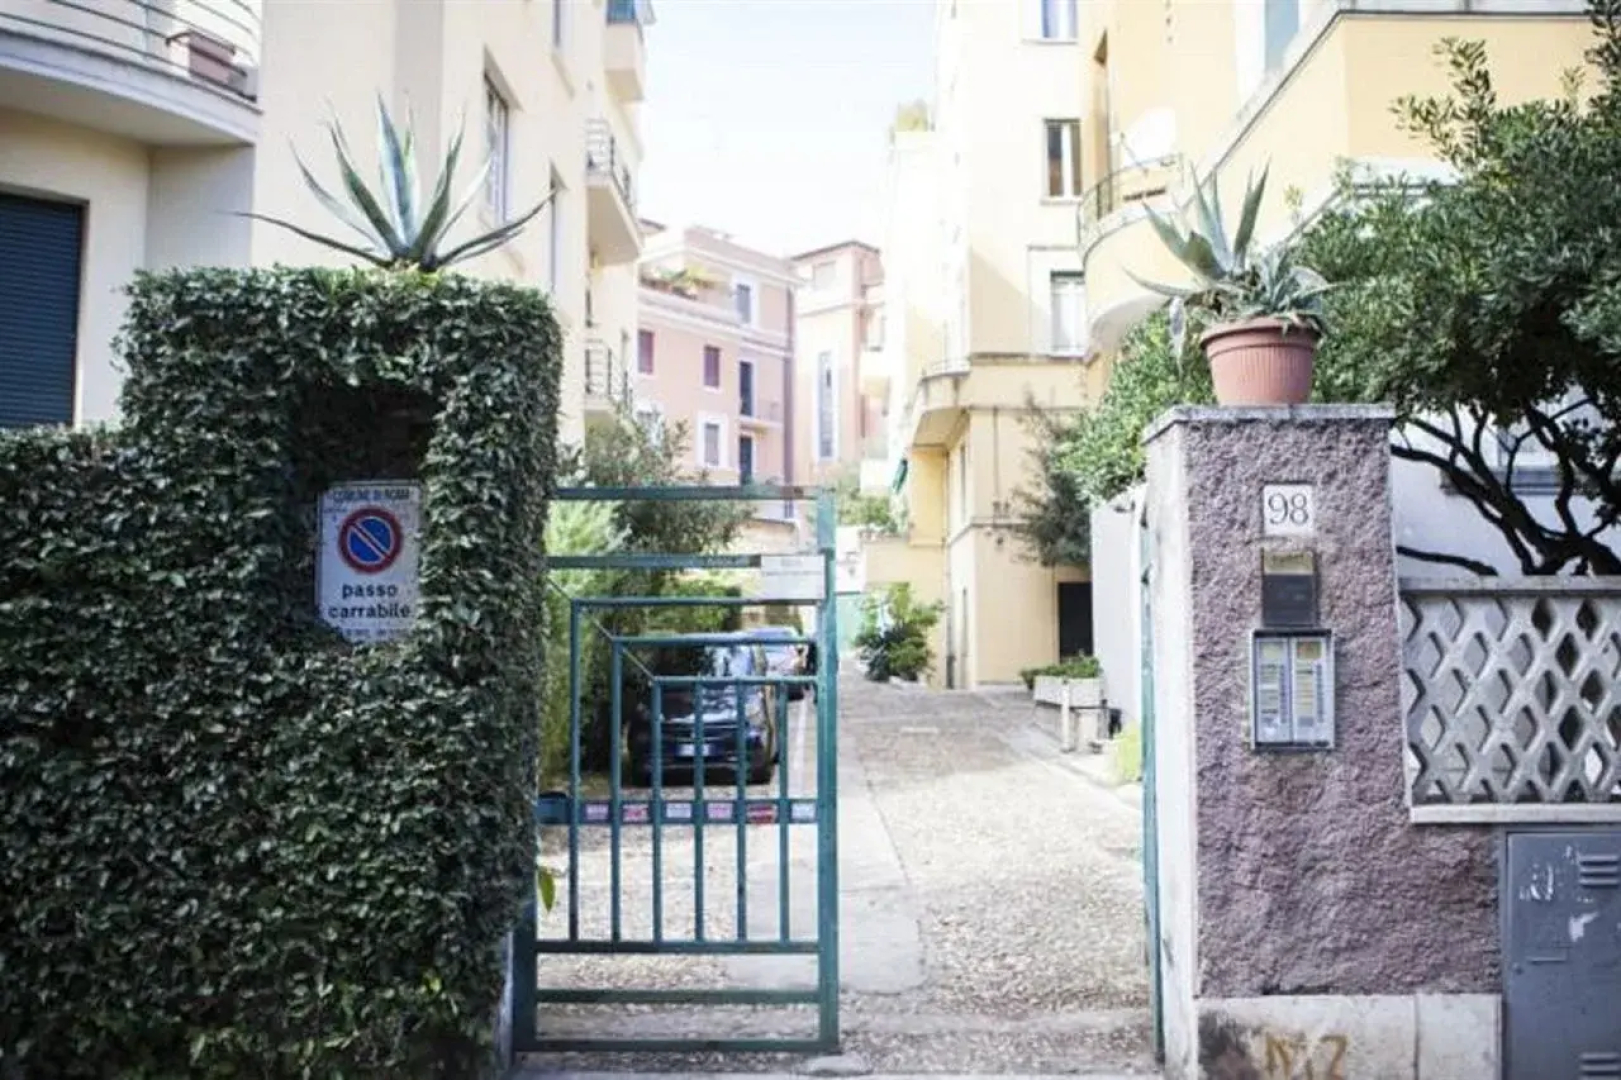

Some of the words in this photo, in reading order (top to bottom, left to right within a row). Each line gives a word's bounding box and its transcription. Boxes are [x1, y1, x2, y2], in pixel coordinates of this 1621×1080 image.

[1268, 492, 1309, 525] 98
[342, 583, 398, 600] passo
[328, 602, 410, 619] carrabile
